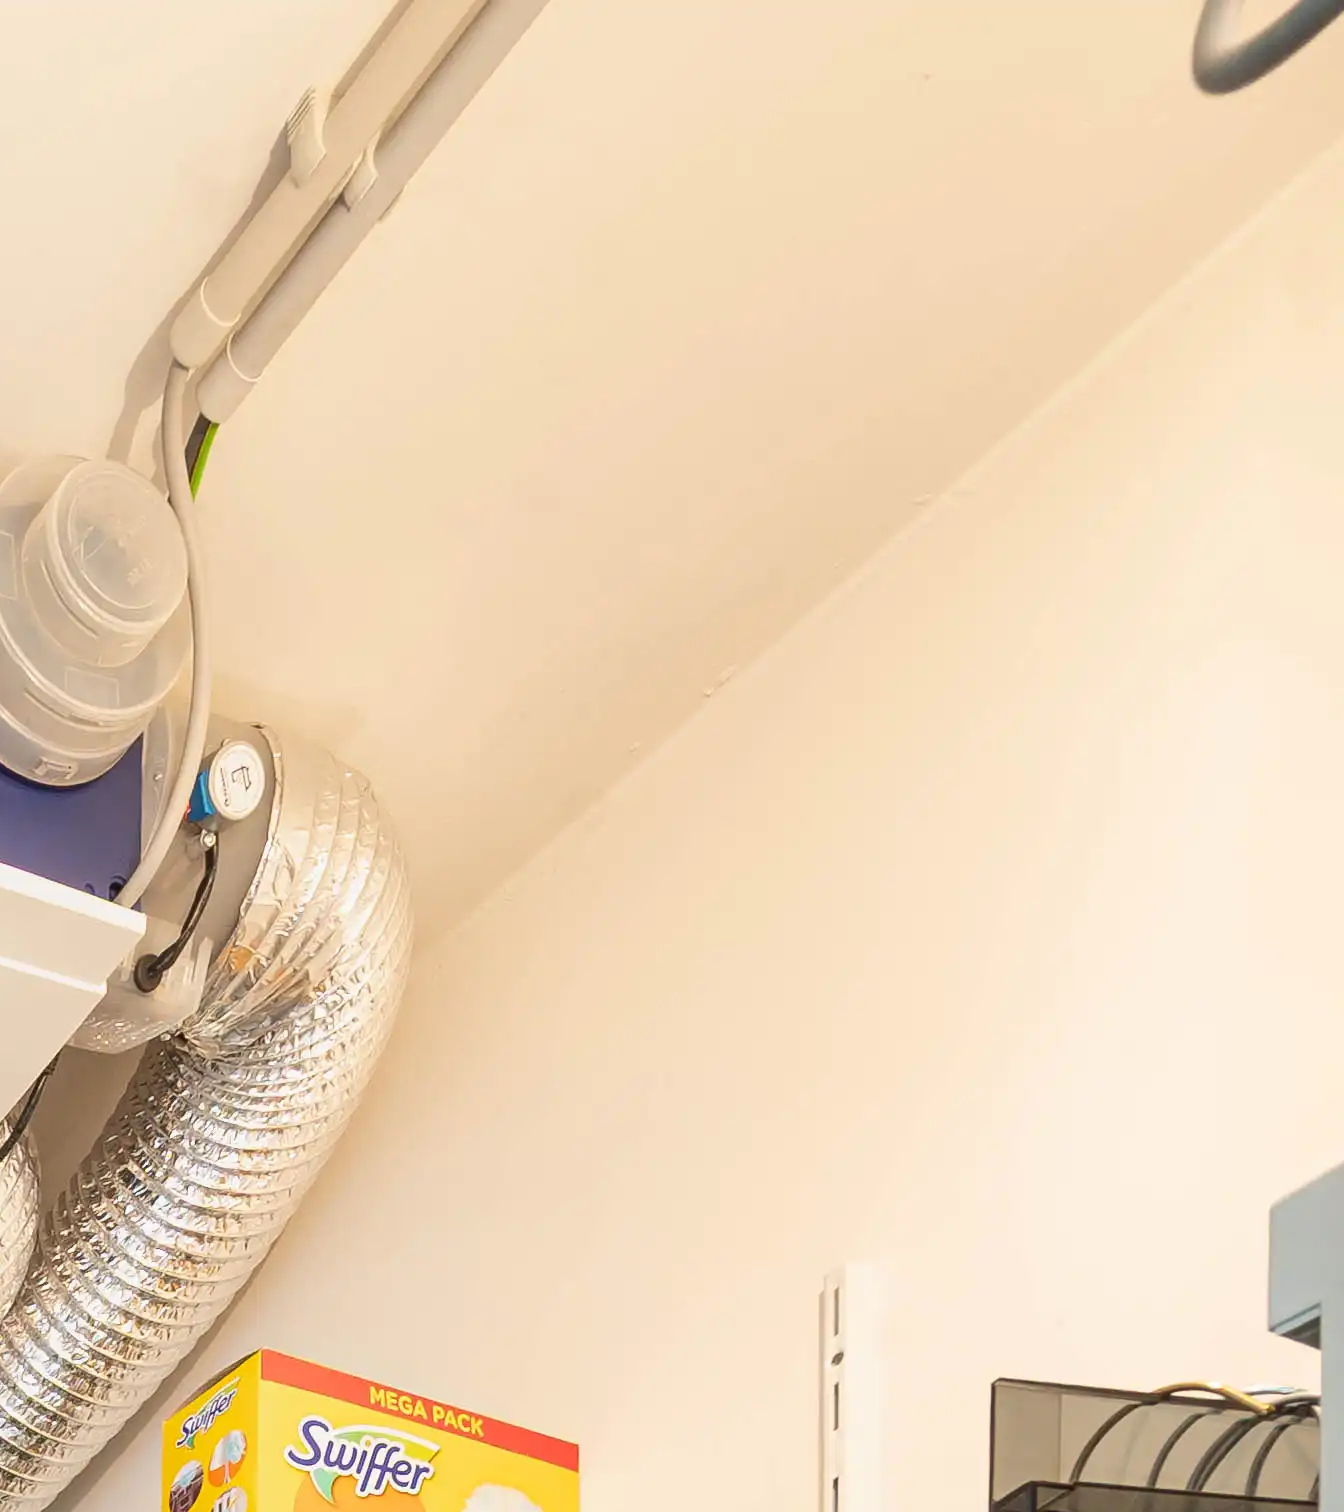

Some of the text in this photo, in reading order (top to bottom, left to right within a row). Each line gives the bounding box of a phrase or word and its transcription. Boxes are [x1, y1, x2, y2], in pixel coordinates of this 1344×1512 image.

[177, 1388, 236, 1446] Swiffer
[370, 1387, 484, 1438] MEGA PACK
[288, 1420, 430, 1491] Swiffer
